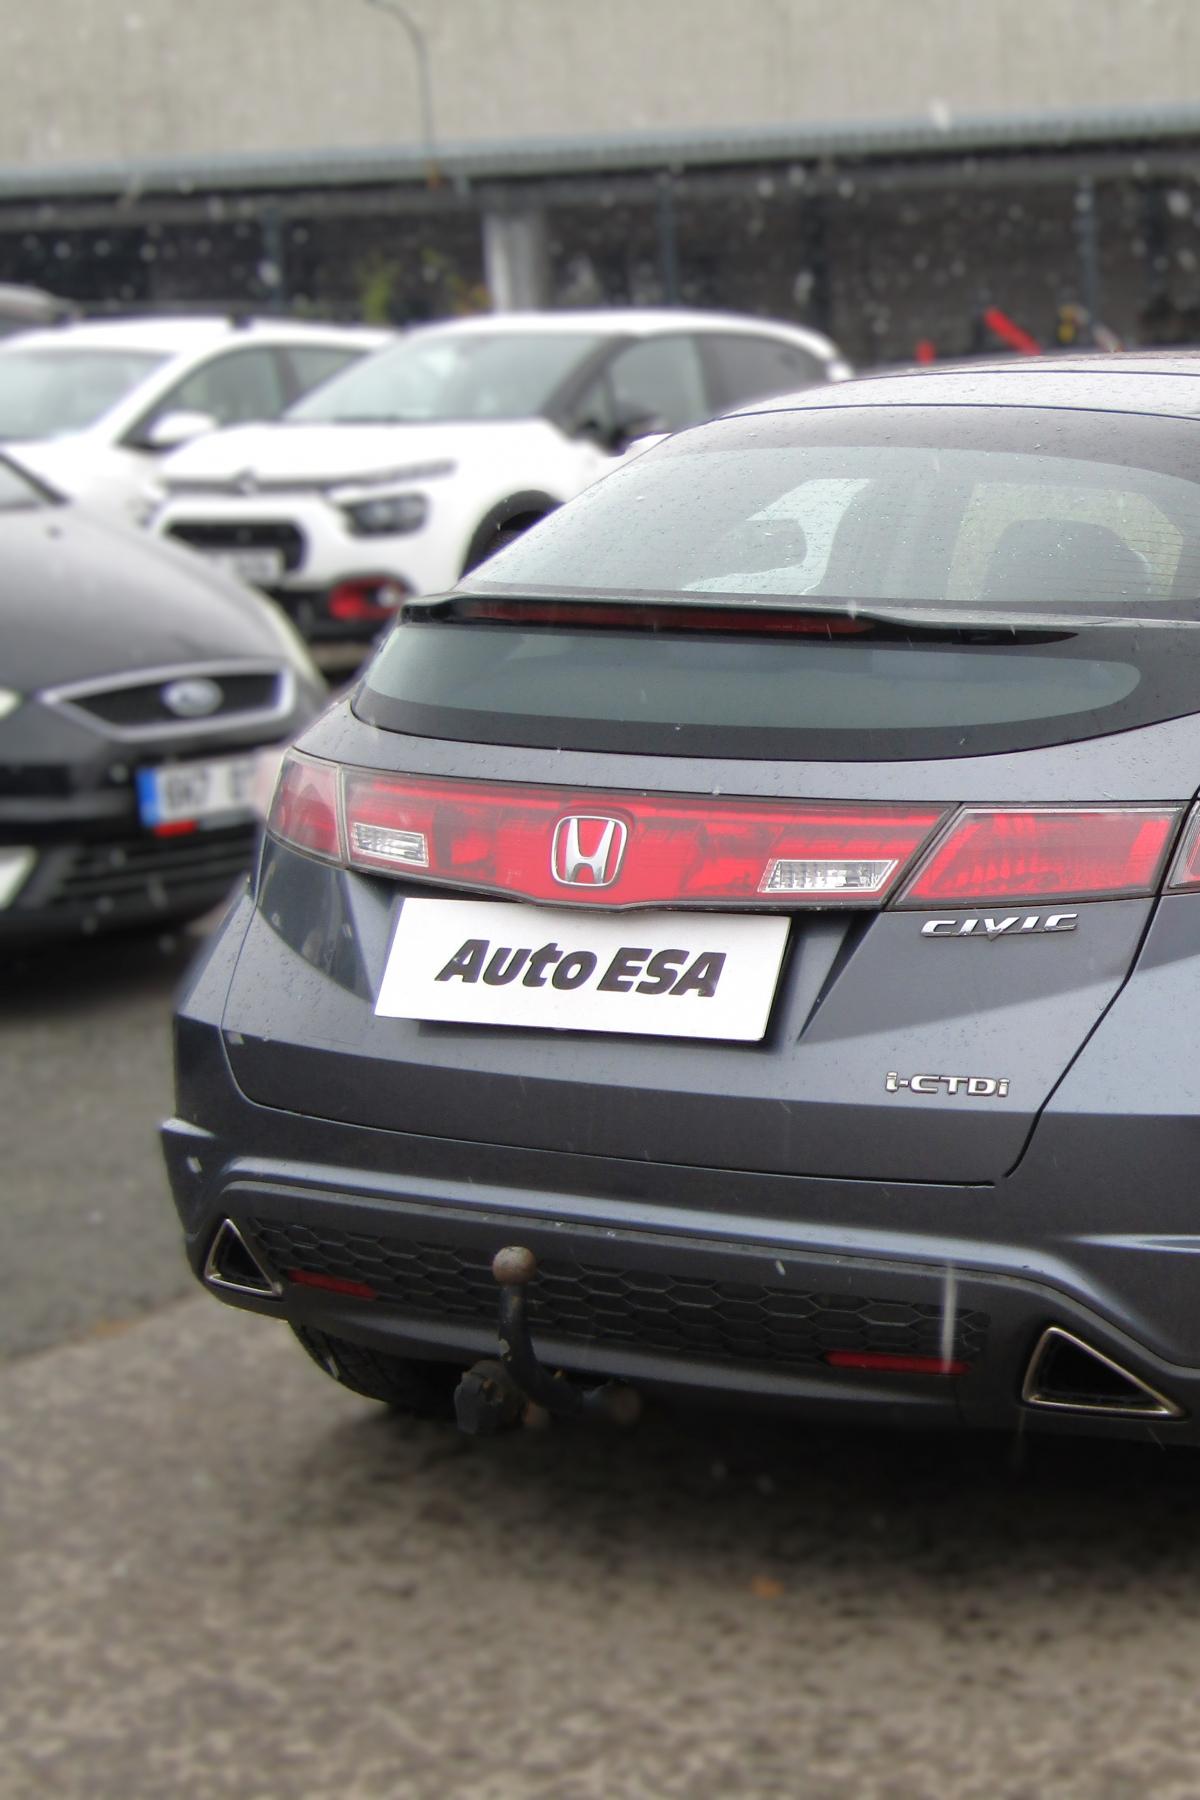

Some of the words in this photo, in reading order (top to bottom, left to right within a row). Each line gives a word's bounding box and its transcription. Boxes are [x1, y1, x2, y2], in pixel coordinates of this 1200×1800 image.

[921, 913, 1078, 941] CIVIC
[434, 938, 598, 990] Auto
[596, 947, 727, 998] ESA
[885, 1071, 1010, 1098] i-CTDi
